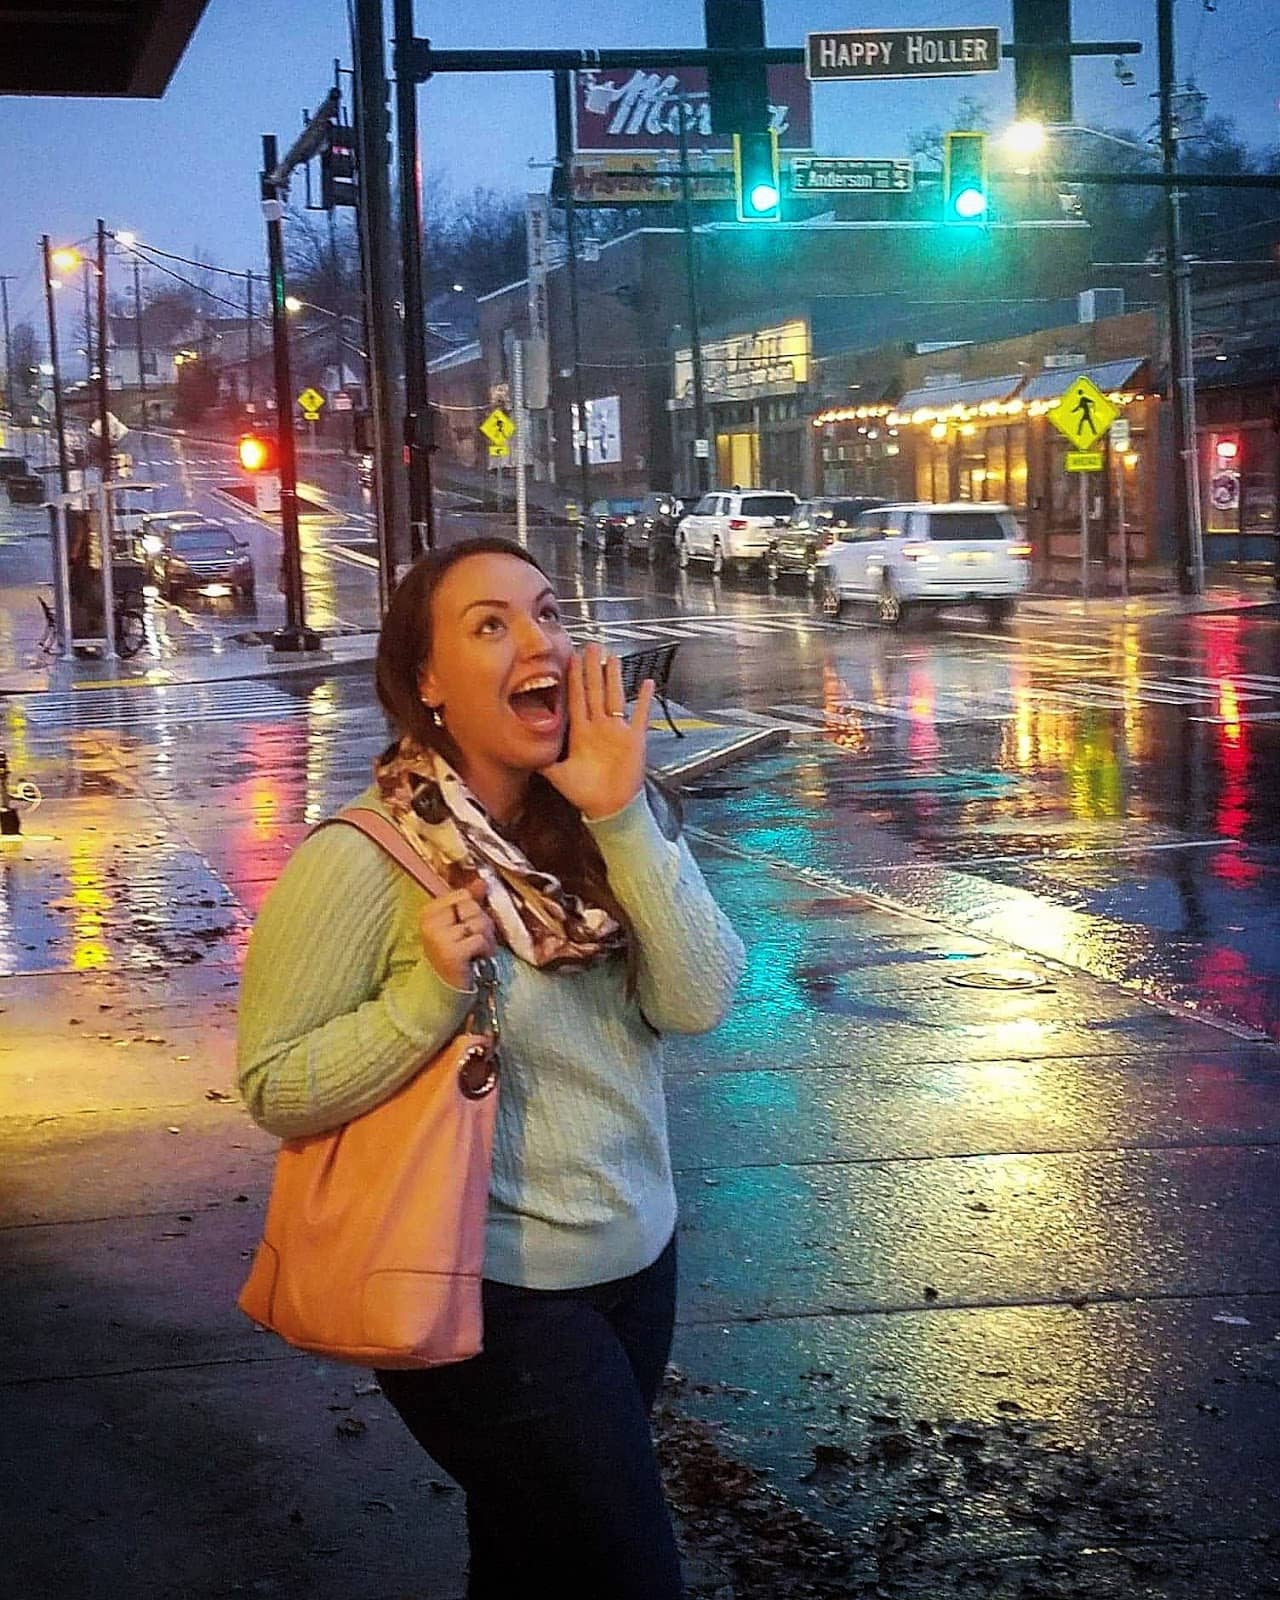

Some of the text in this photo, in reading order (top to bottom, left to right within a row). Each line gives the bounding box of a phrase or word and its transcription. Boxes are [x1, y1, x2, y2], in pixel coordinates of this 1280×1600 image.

[820, 35, 988, 67] HAPPY HOLLER
[807, 170, 873, 188] Anderson
